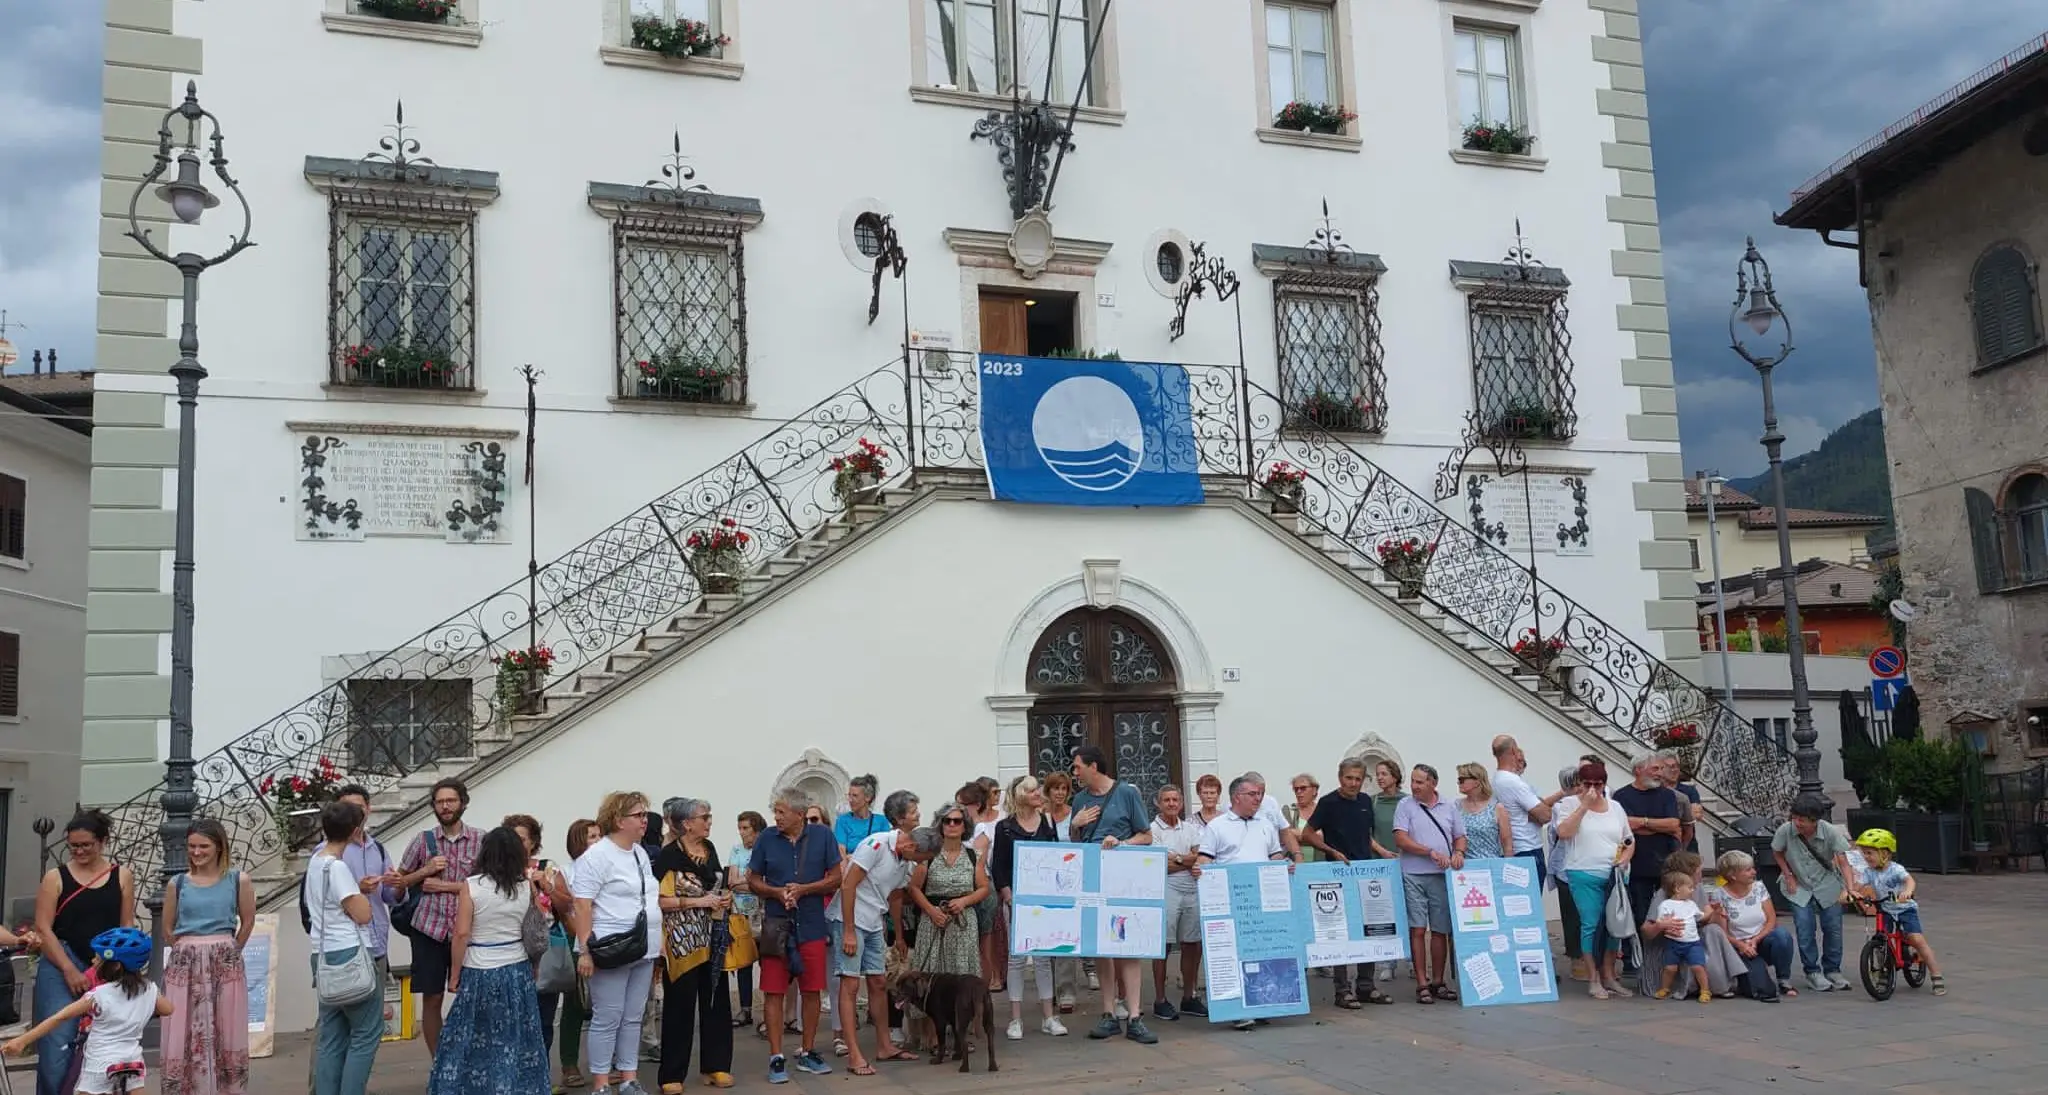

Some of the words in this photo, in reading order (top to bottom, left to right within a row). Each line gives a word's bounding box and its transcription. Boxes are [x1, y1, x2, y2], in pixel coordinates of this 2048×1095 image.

[984, 361, 1023, 376] 2023
[383, 459, 428, 467] QUANDO
[365, 518, 392, 526] VIVA
[1320, 892, 1333, 901] NO
